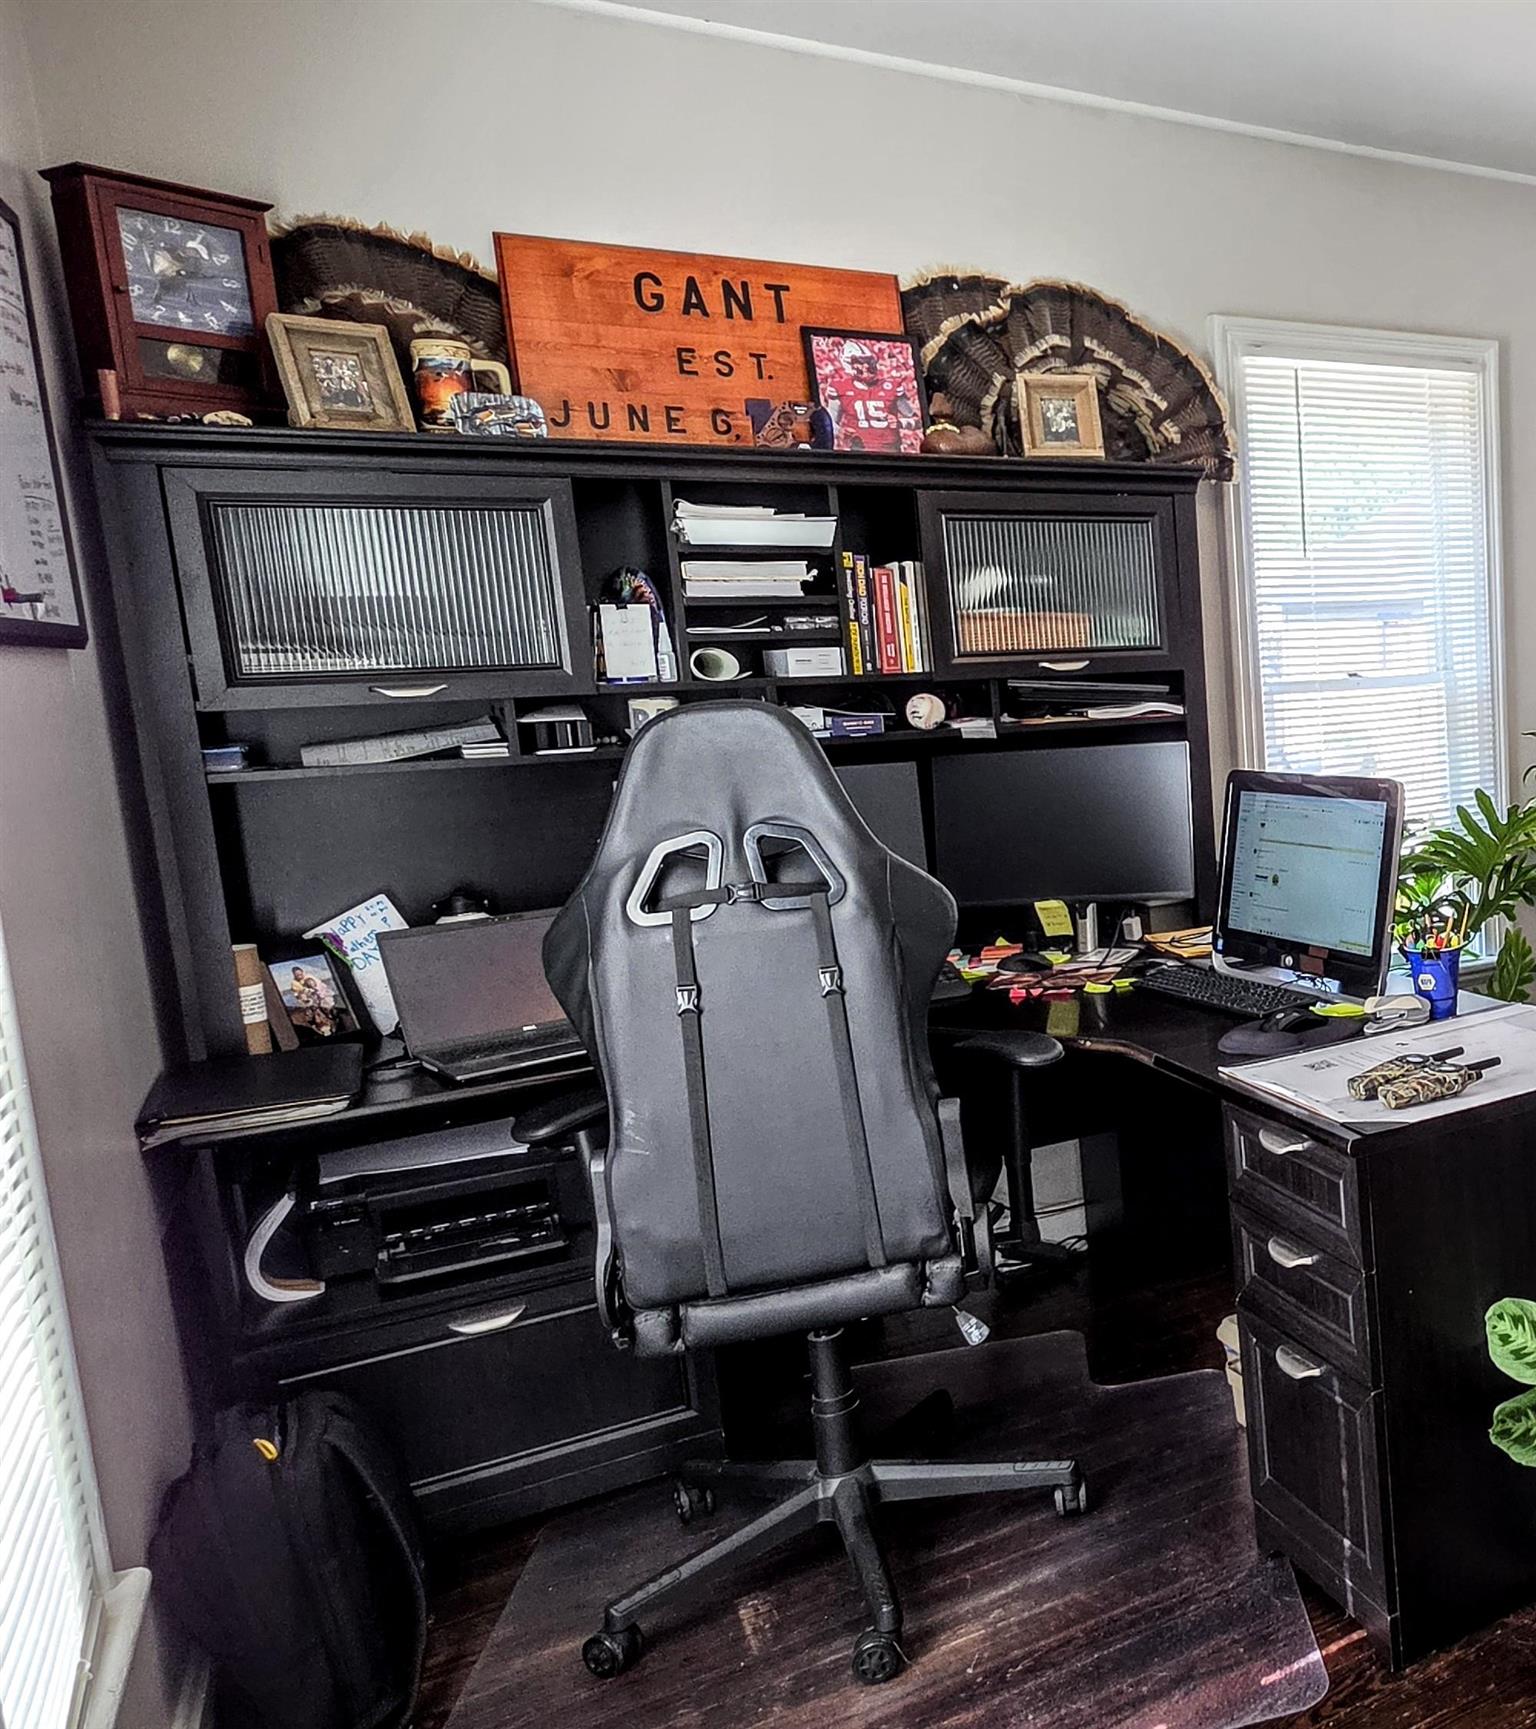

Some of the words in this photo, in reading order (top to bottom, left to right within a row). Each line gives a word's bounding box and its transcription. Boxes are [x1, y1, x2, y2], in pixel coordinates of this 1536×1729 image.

[121, 232, 138, 251] 10
[163, 221, 182, 235] 12
[633, 271, 791, 324] GANT
[676, 346, 775, 381] EST.
[550, 400, 686, 434] JUNE
[854, 400, 888, 428] 15
